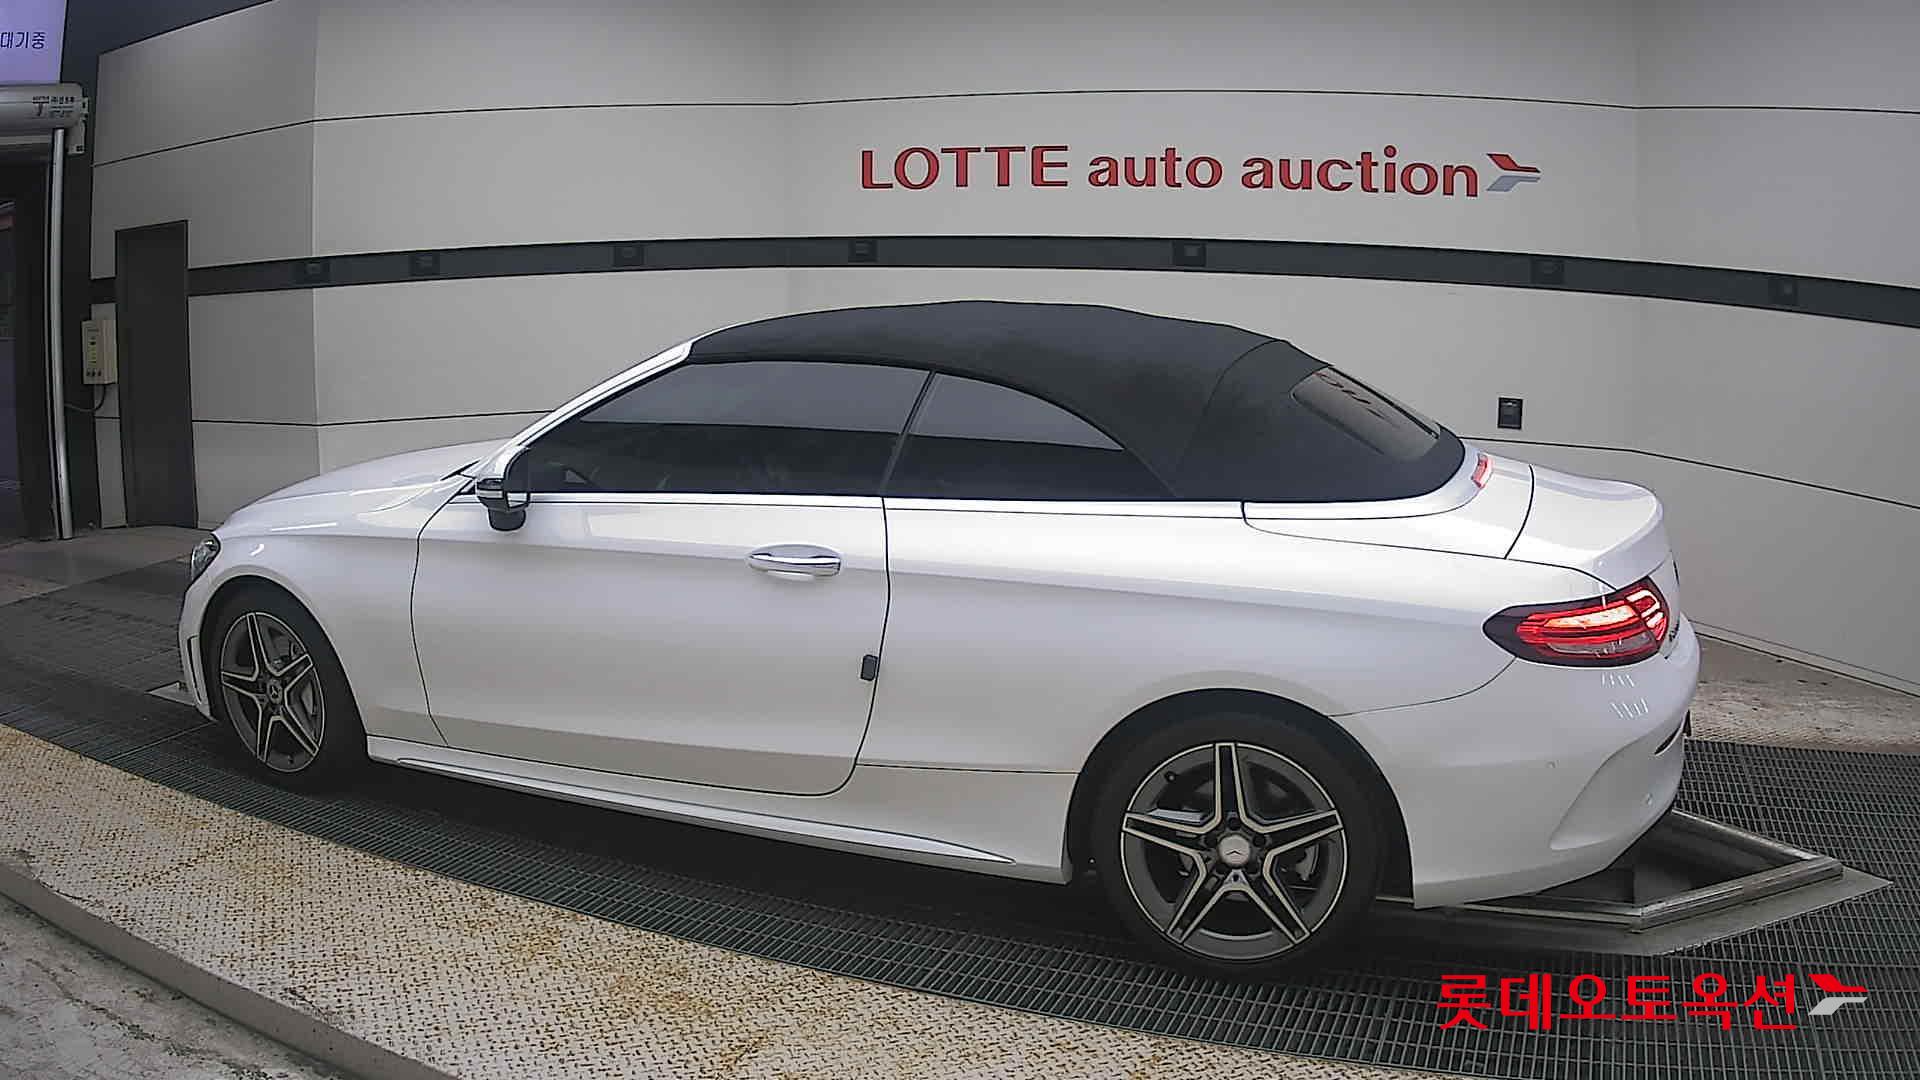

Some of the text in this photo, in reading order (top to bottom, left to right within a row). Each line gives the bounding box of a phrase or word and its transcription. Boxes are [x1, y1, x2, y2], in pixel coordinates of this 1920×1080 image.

[0, 31, 46, 50] 대기중
[861, 145, 1478, 197] LOTTE auto auction
